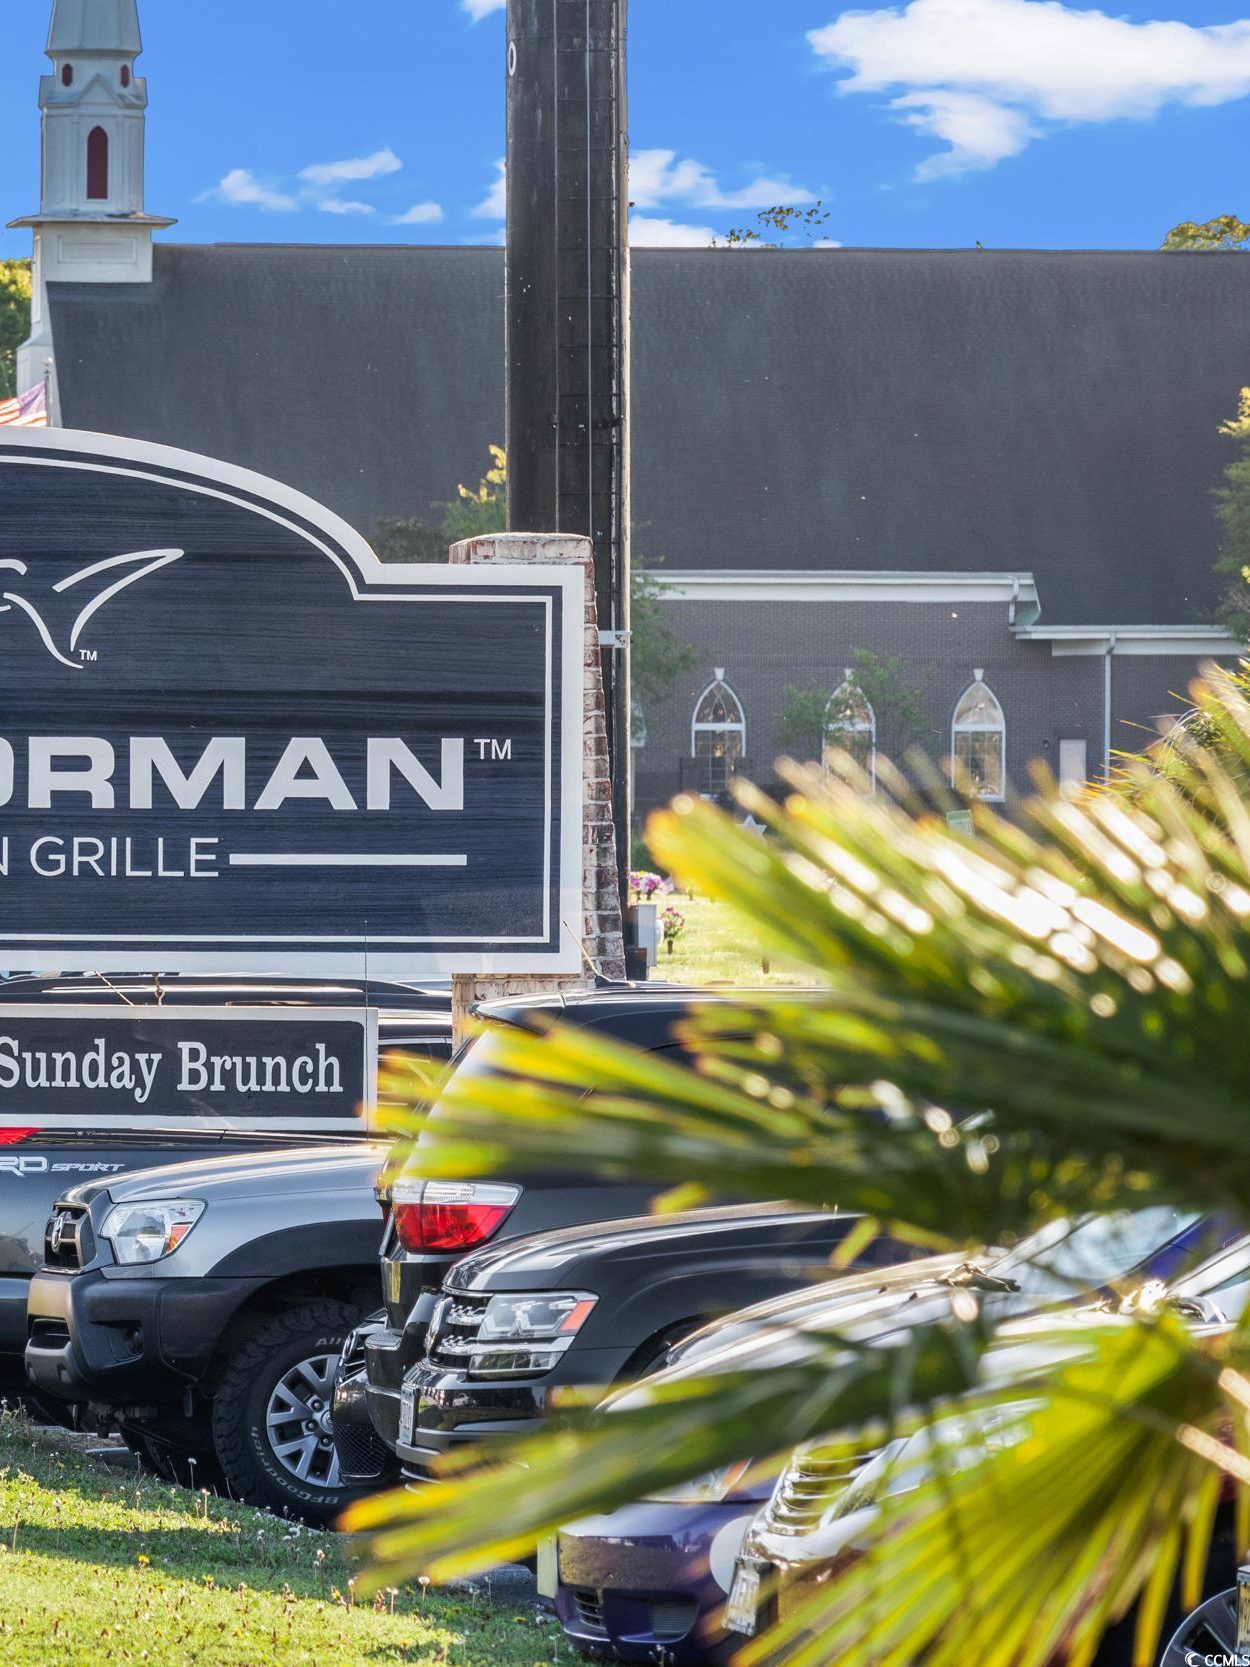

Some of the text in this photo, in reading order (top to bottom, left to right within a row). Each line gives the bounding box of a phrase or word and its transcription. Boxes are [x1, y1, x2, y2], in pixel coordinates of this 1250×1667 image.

[78, 649, 98, 661] TM
[30, 836, 219, 877] GRILLE
[176, 1041, 344, 1093] Brunch
[51, 1161, 126, 1172] SPORT
